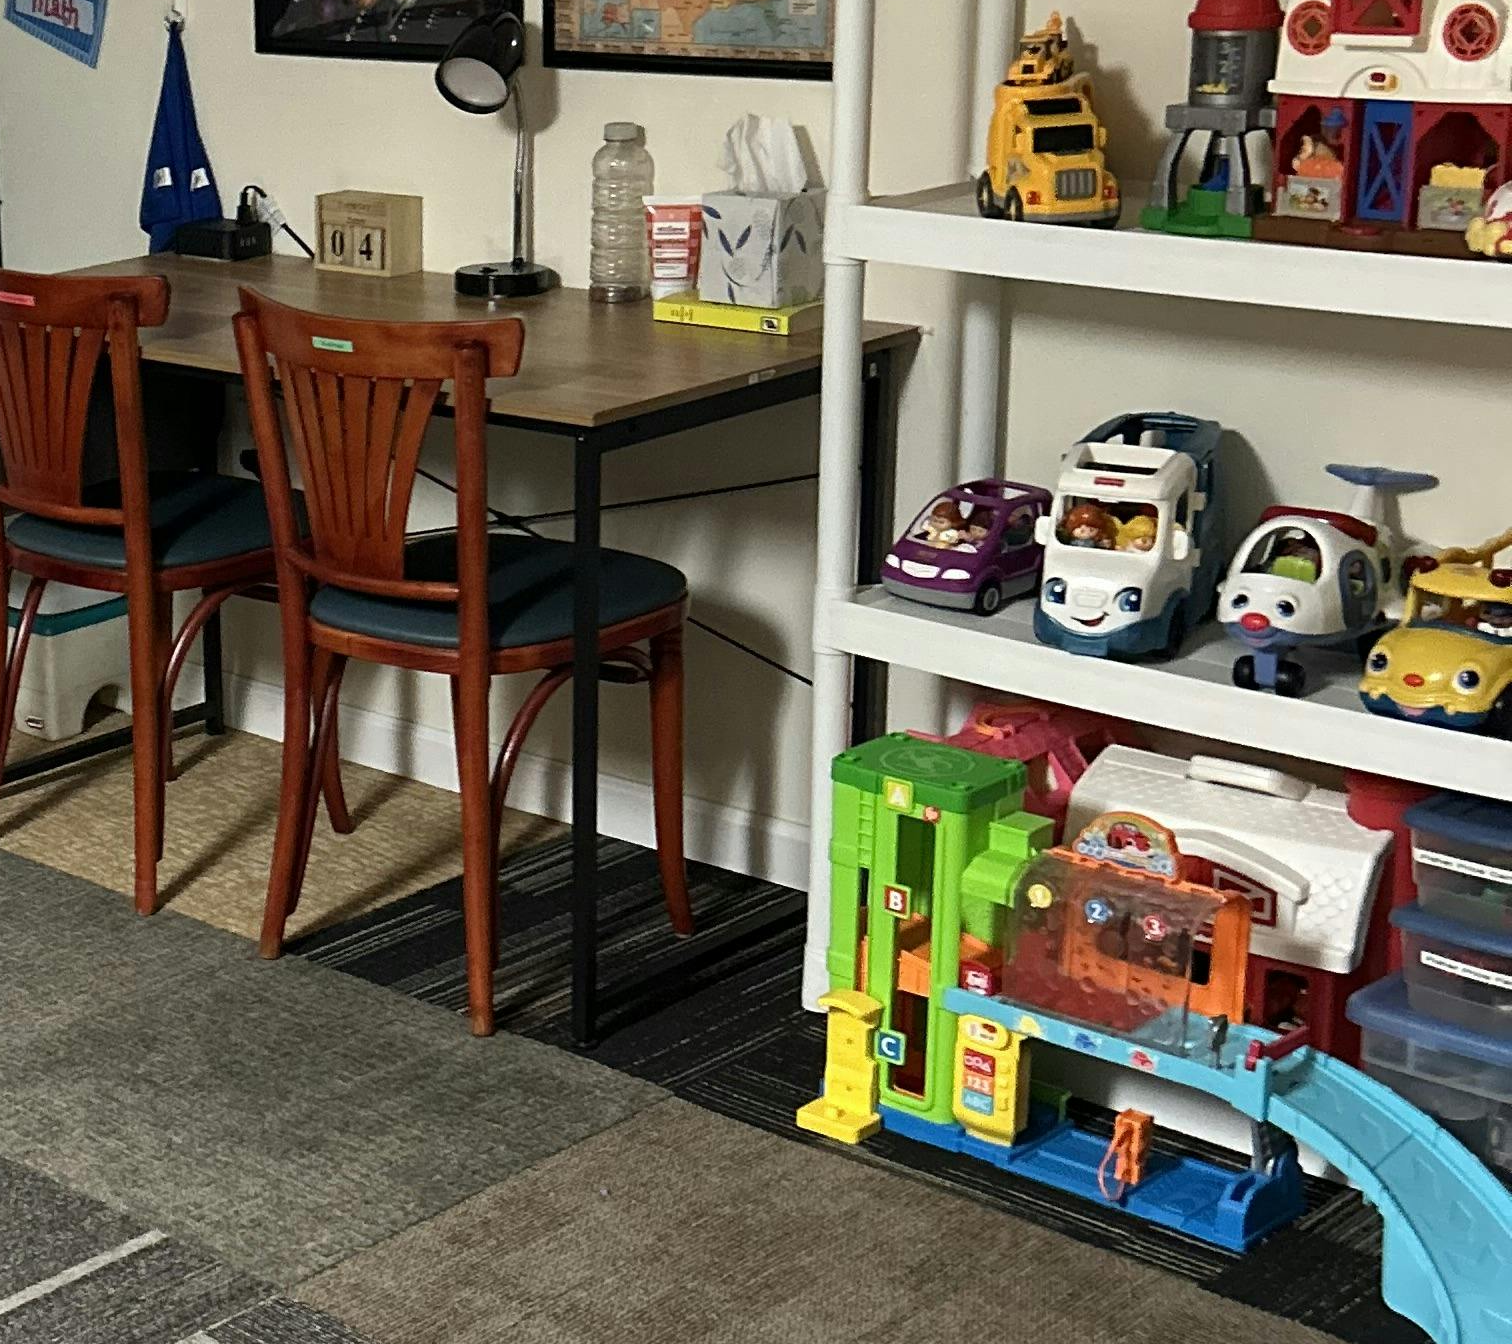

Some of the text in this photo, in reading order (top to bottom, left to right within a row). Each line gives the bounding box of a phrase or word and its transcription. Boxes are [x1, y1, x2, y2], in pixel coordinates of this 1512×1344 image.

[890, 786, 907, 808] A
[889, 890, 903, 911] B
[1090, 903, 1103, 919] 2
[1149, 918, 1161, 934] 3
[881, 1037, 897, 1057] C
[966, 1075, 989, 1092] 123
